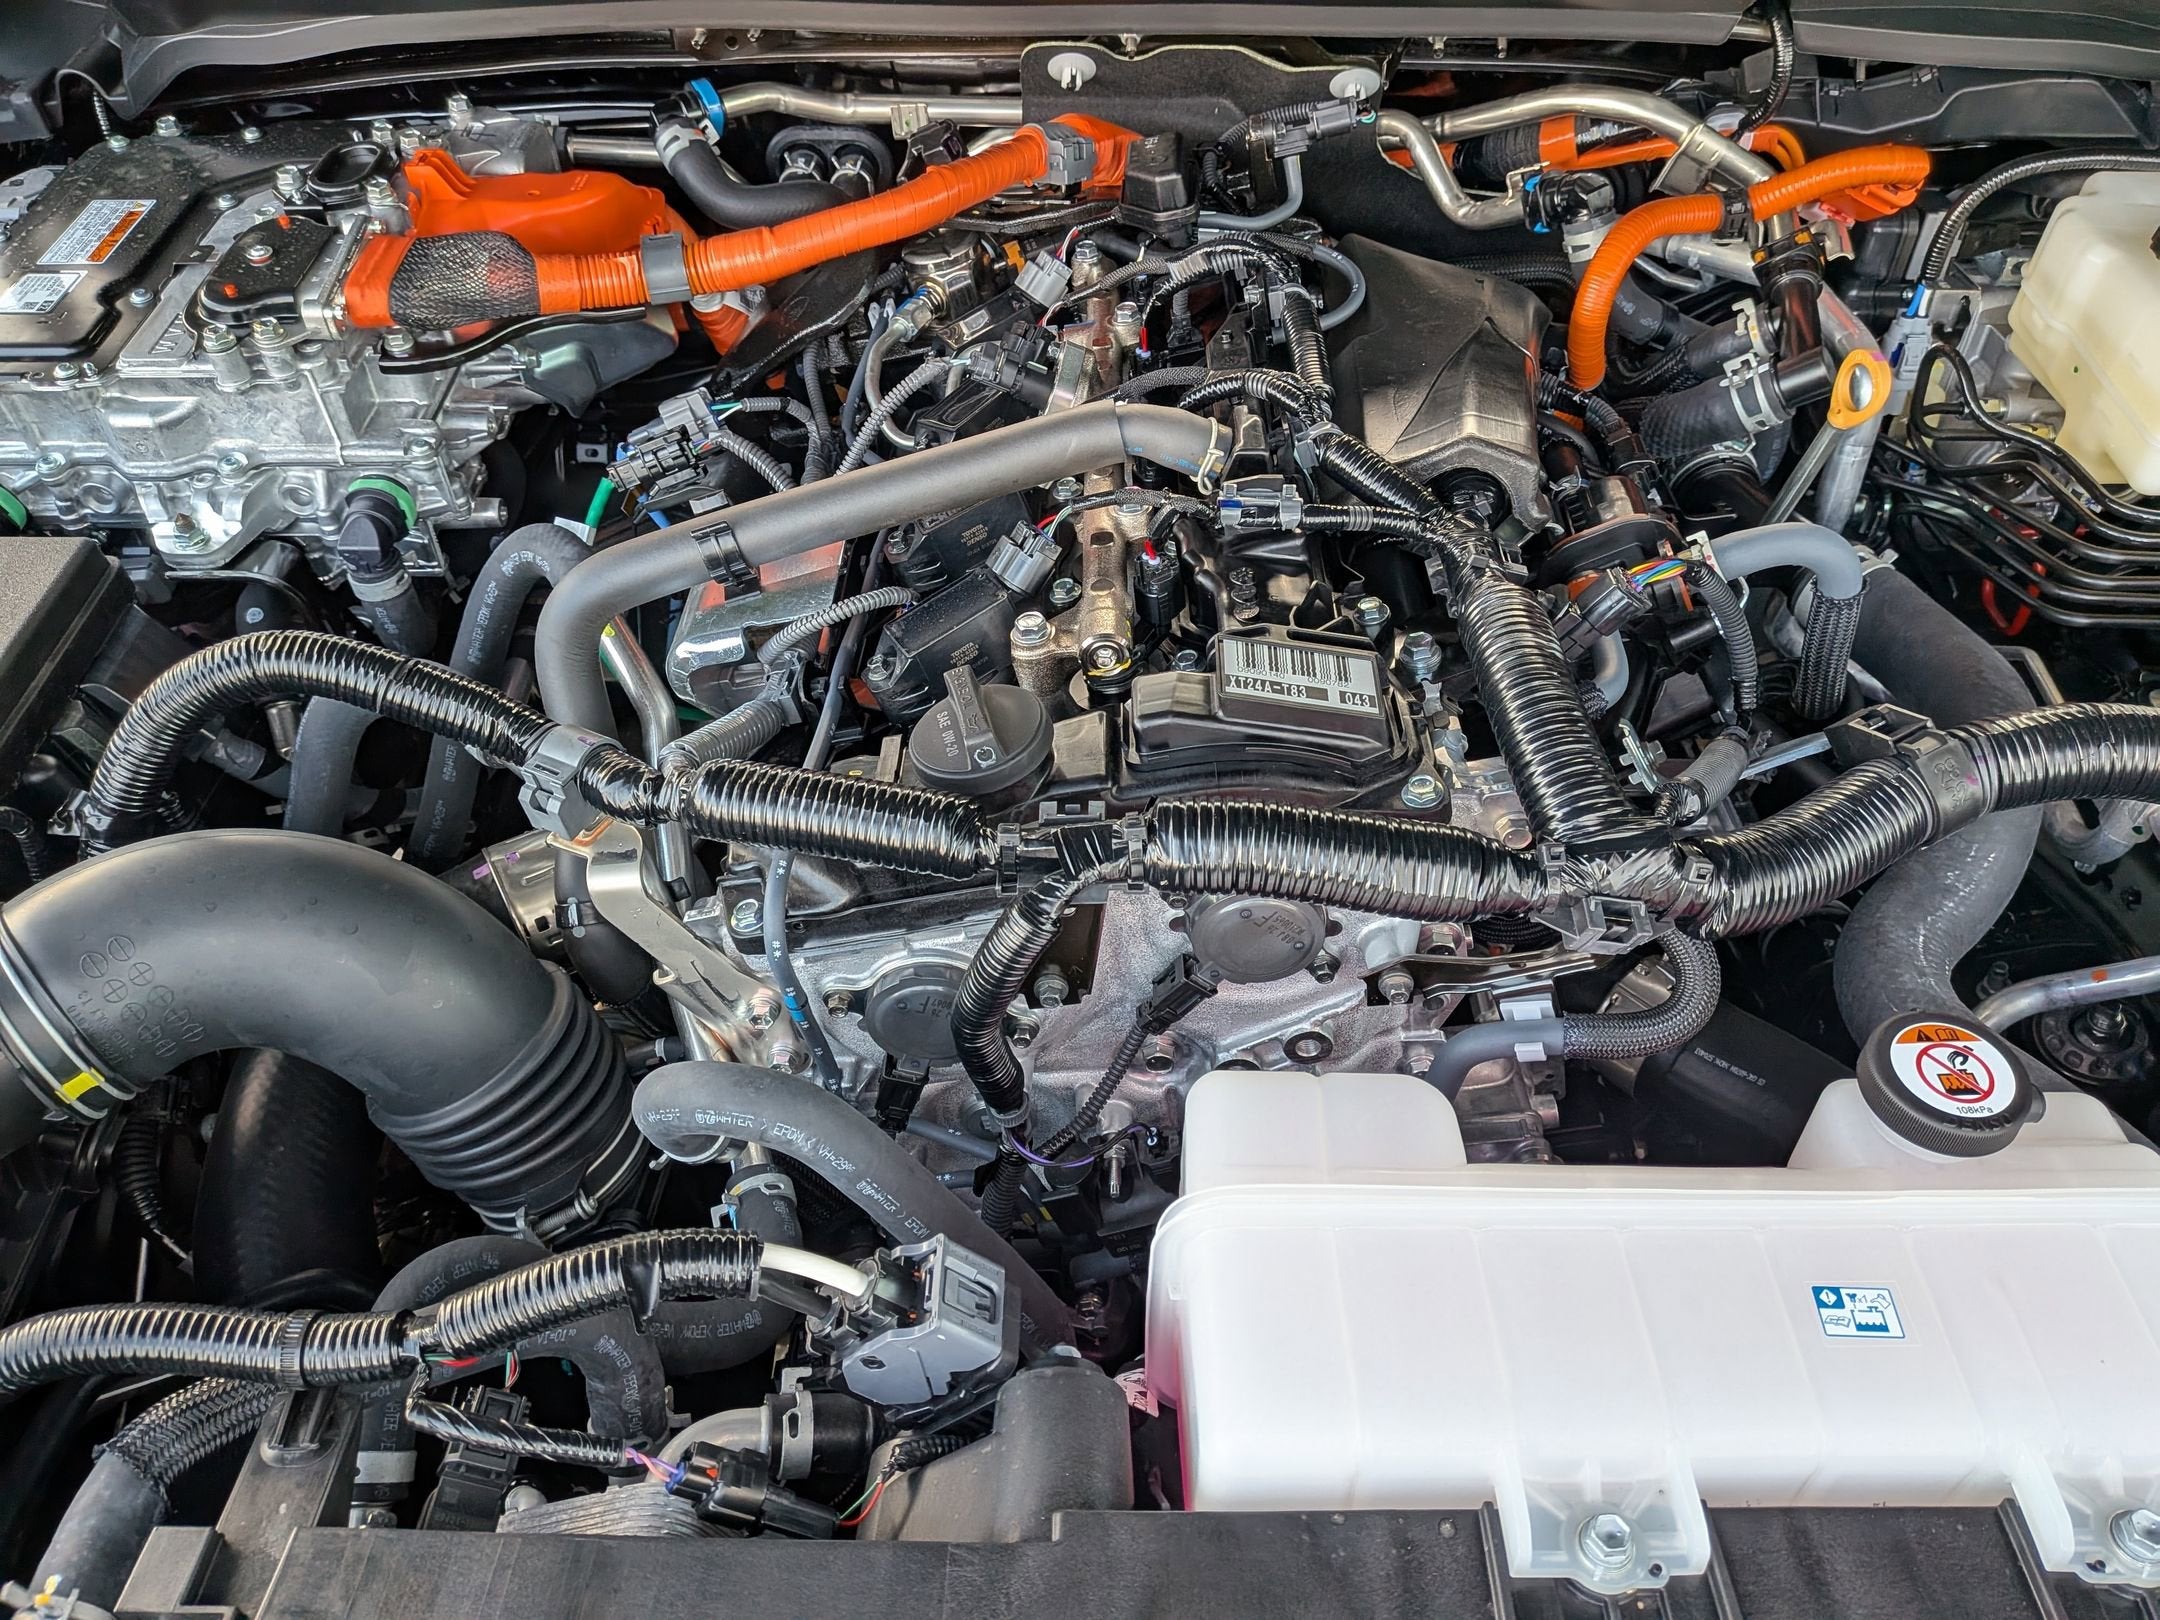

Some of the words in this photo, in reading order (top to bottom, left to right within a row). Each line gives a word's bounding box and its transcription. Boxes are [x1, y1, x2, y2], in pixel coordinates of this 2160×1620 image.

[962, 524, 984, 537] TOYOTA
[966, 532, 988, 546] DENSO
[950, 642, 974, 658] TOYOTA
[957, 651, 979, 667] DENSO
[1237, 666, 1286, 680] 09090140
[1229, 676, 1308, 699] XT24A-T83
[1345, 693, 1371, 708] 043
[936, 711, 951, 729] SAE
[942, 730, 959, 758] 0W-20
[1955, 1105, 1994, 1115] 108kPa
